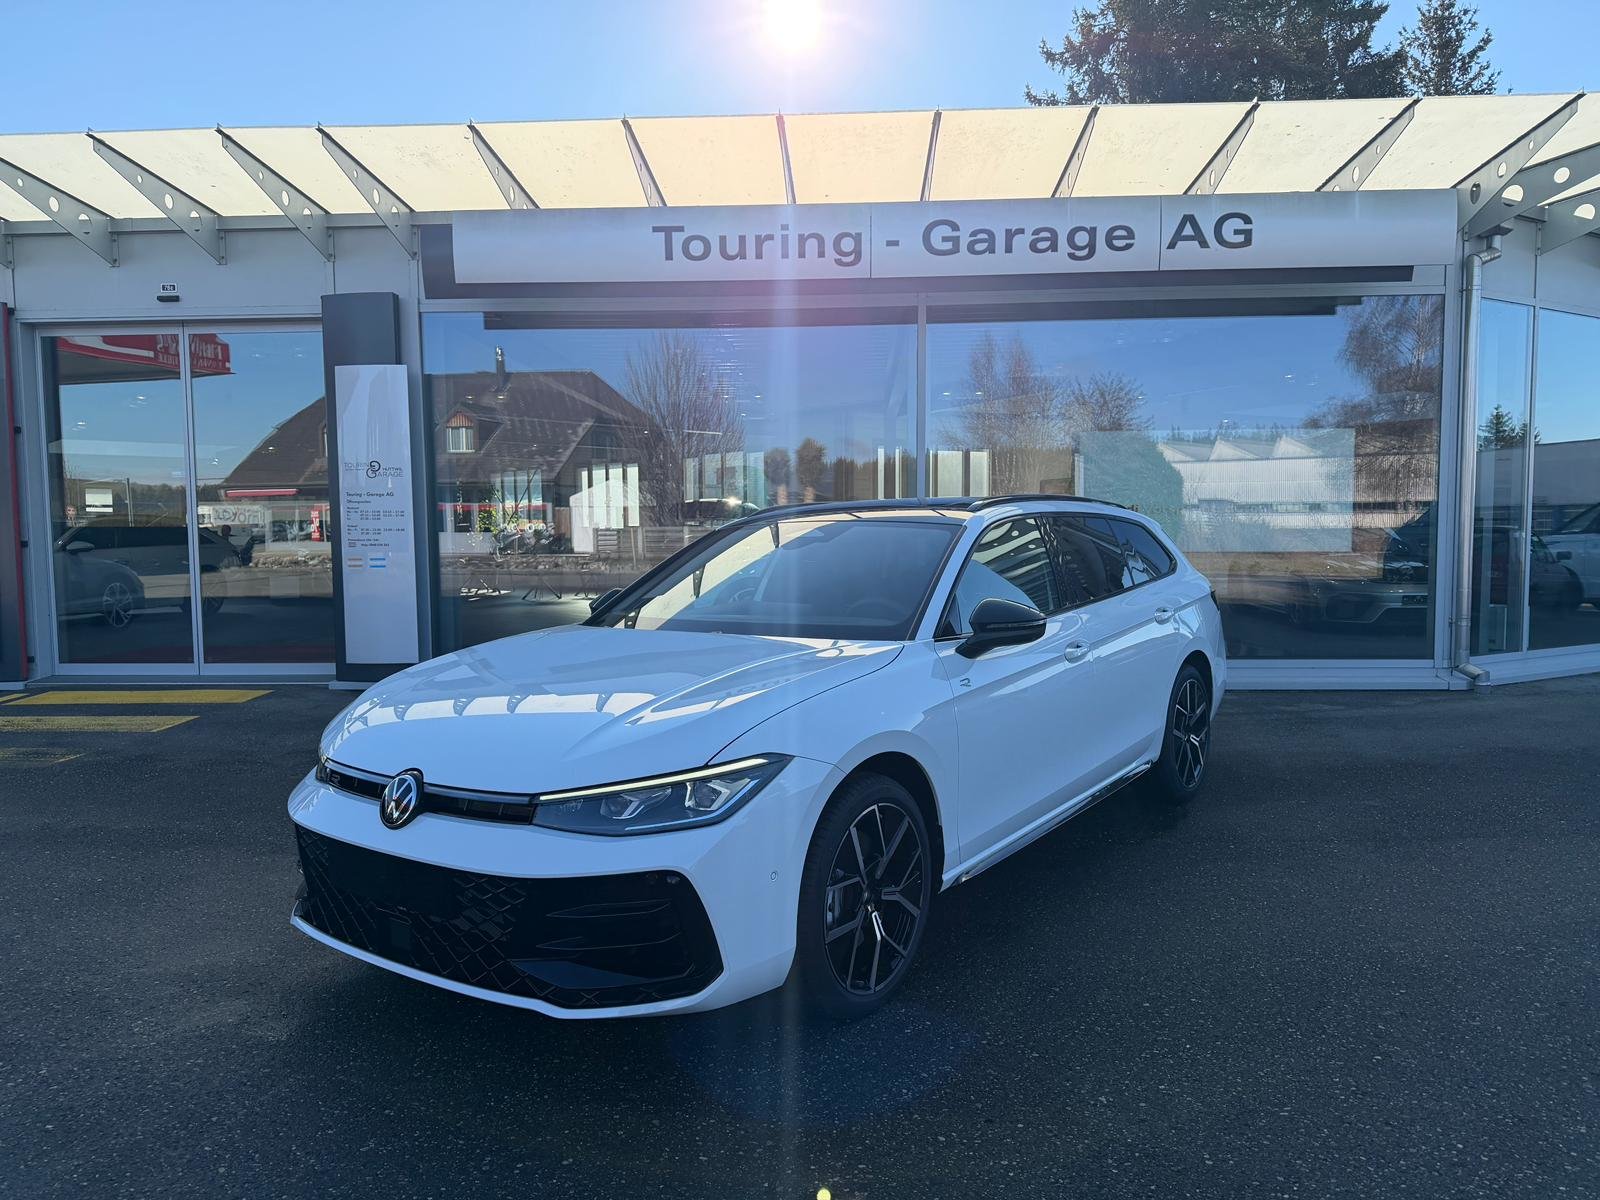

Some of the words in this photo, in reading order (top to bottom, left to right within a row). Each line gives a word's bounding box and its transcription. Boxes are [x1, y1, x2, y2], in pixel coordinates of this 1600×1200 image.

[652, 224, 863, 267] Touring
[921, 219, 1136, 261] Garage
[1166, 212, 1254, 250] AG
